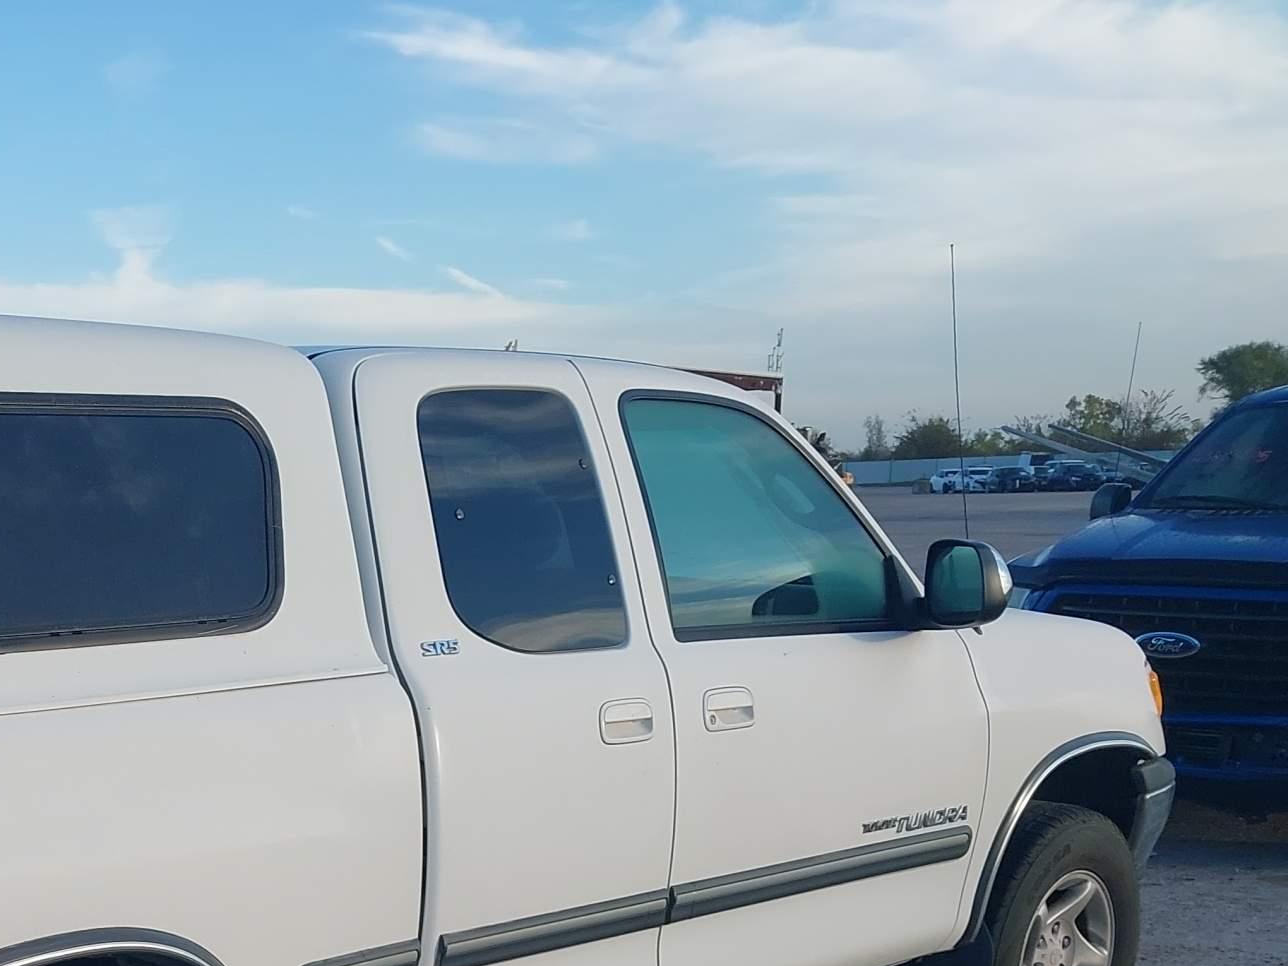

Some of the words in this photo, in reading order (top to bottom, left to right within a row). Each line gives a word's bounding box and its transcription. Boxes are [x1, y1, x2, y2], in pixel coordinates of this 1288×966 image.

[420, 640, 460, 657] SR5
[1148, 637, 1183, 653] Ford
[896, 804, 968, 833] TUNDRA
